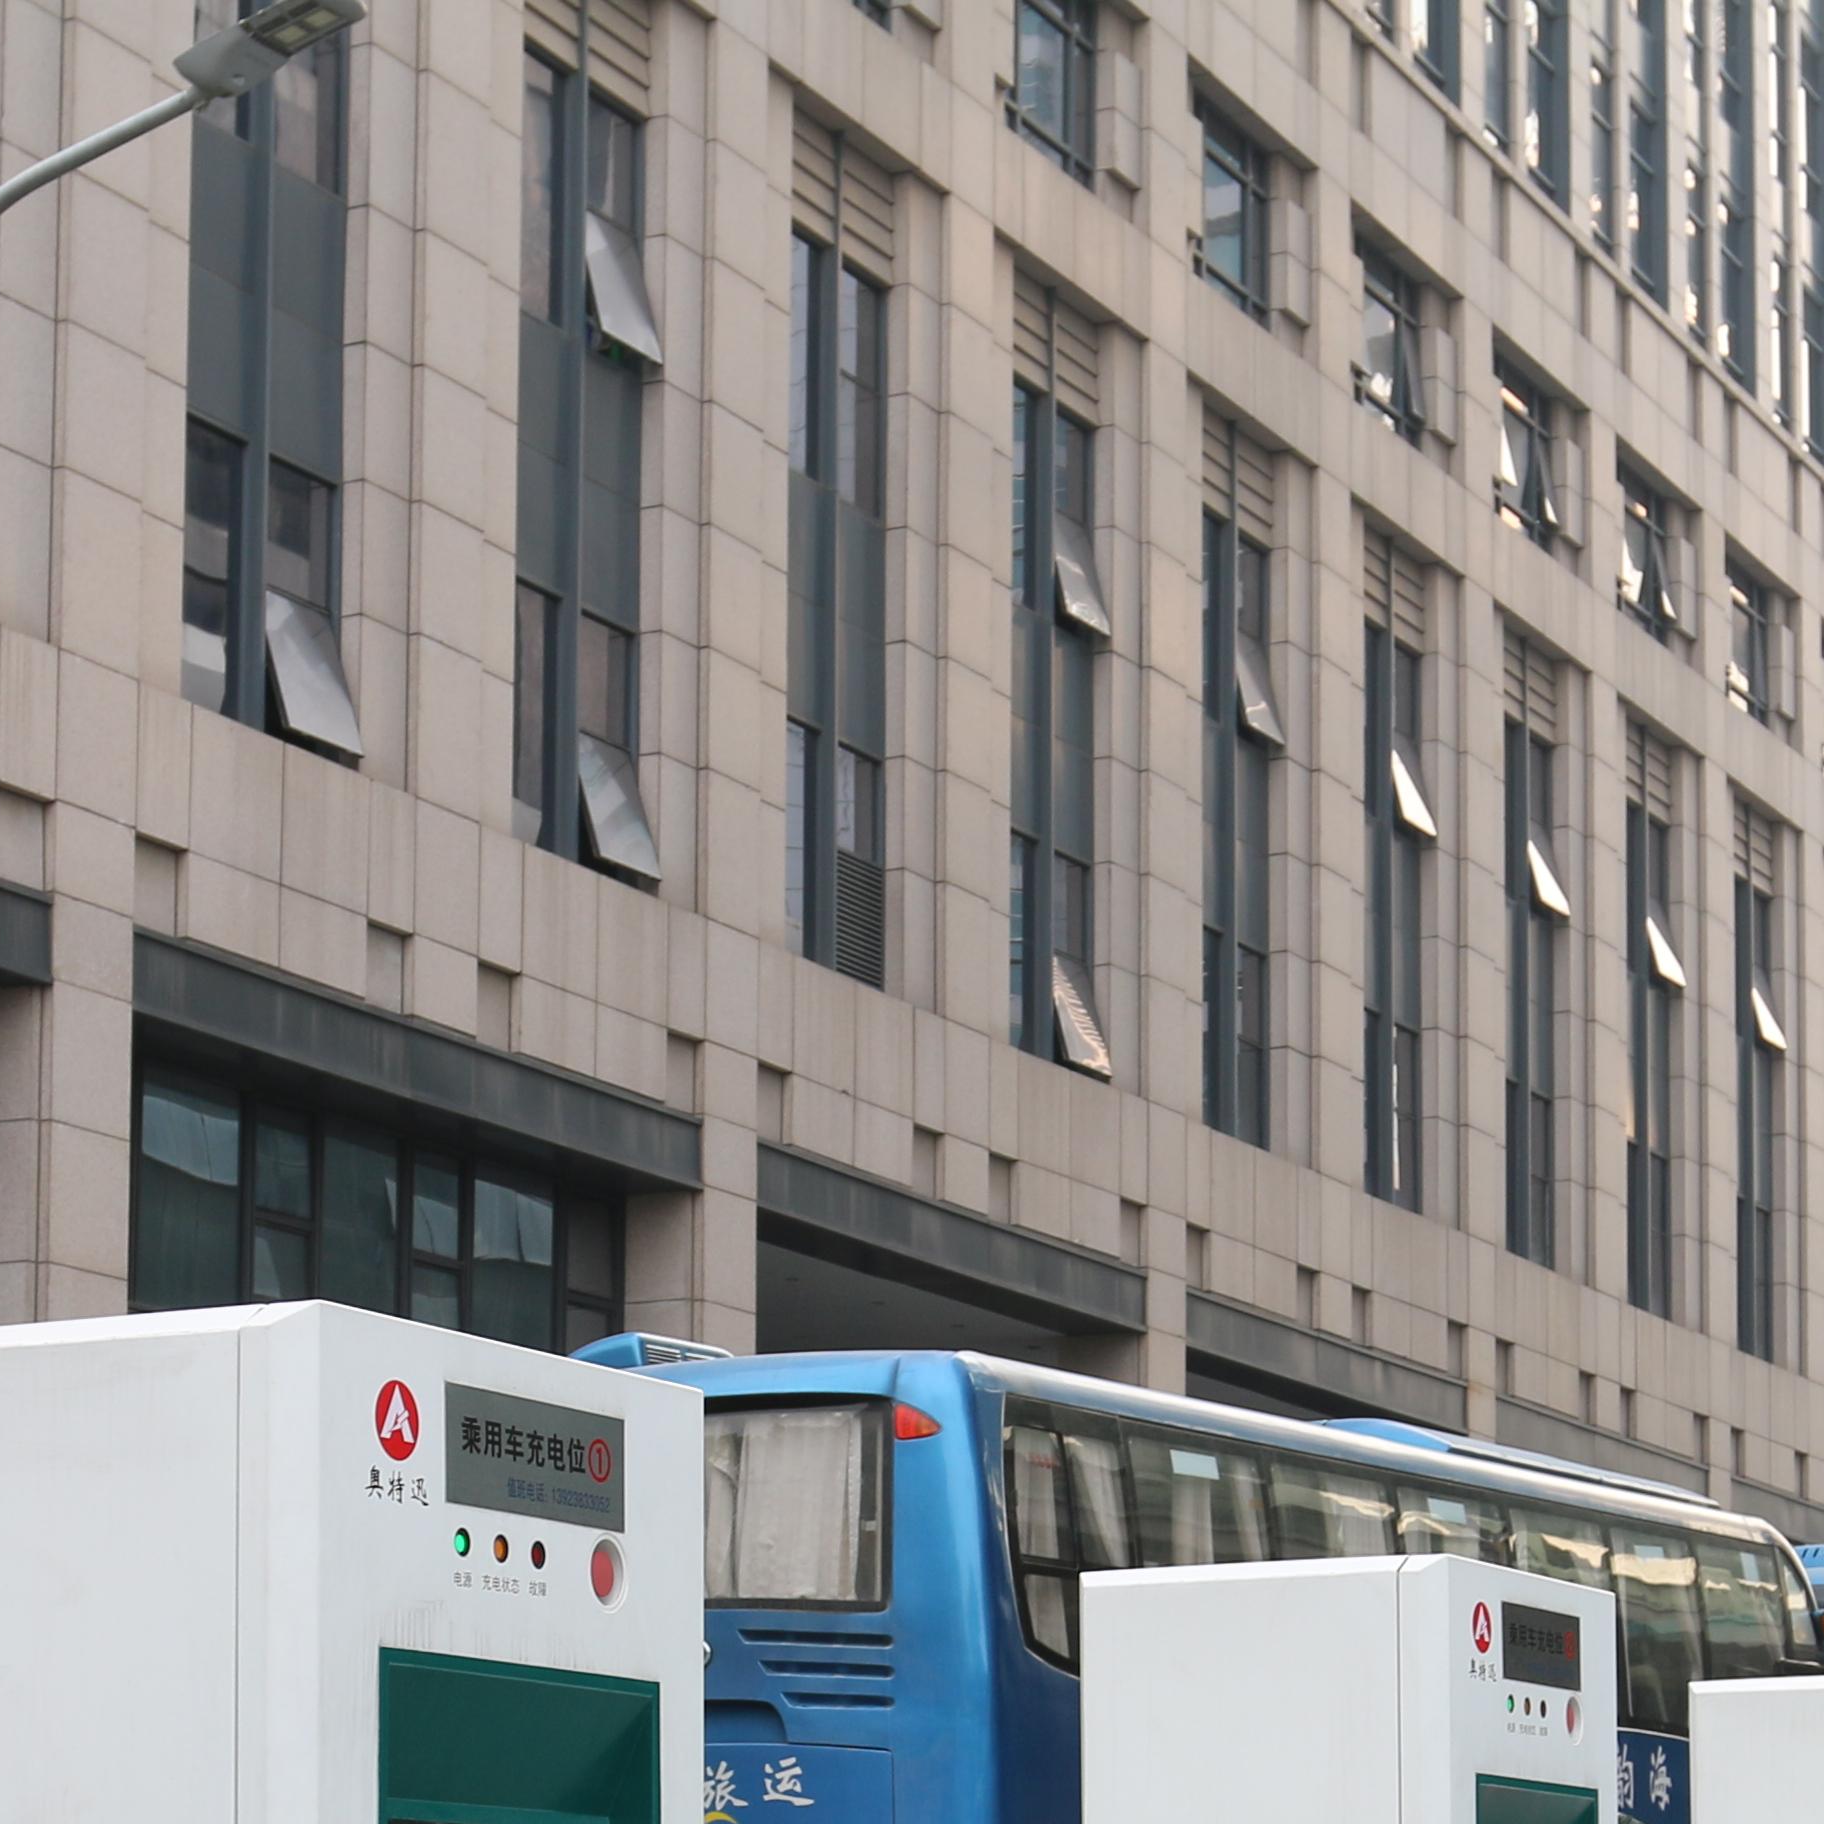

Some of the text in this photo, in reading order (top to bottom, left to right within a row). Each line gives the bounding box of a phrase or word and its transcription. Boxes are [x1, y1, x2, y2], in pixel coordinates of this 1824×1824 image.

[364, 1464, 429, 1507] 奥特迅
[453, 1571, 547, 1597] 电源 充电状态 故障
